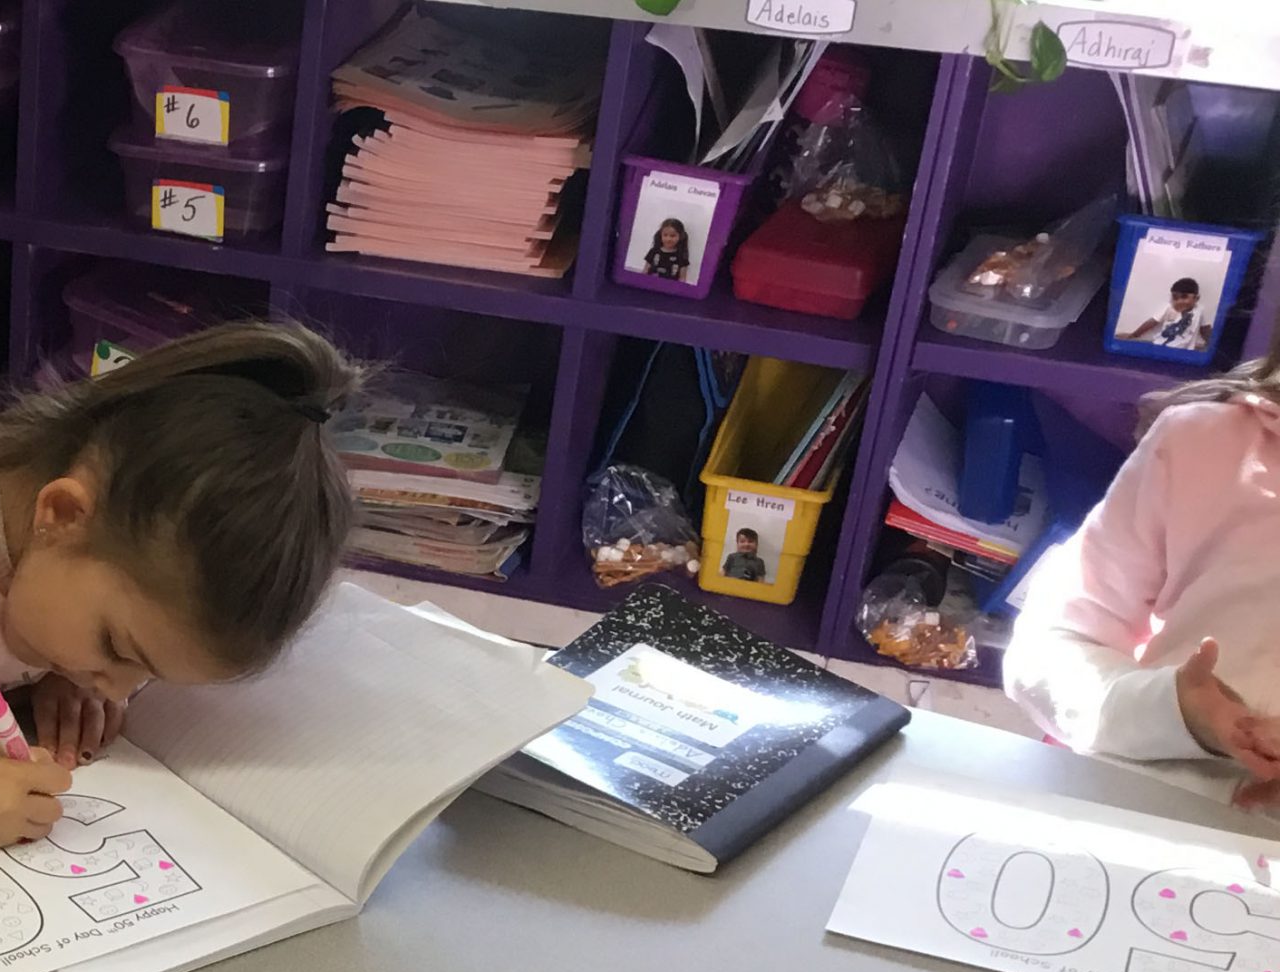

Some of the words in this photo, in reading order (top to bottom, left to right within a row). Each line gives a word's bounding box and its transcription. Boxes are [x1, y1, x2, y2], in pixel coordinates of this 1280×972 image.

[1067, 26, 1156, 67] Adhiraj
[728, 492, 748, 505] Lee
[611, 684, 675, 711] Journal
[676, 709, 719, 732] Math
[135, 904, 181, 922] Happy
[73, 928, 103, 942] Day
[107, 918, 135, 934] 50th
[56, 938, 71, 950] of
[0, 943, 52, 967] School!
